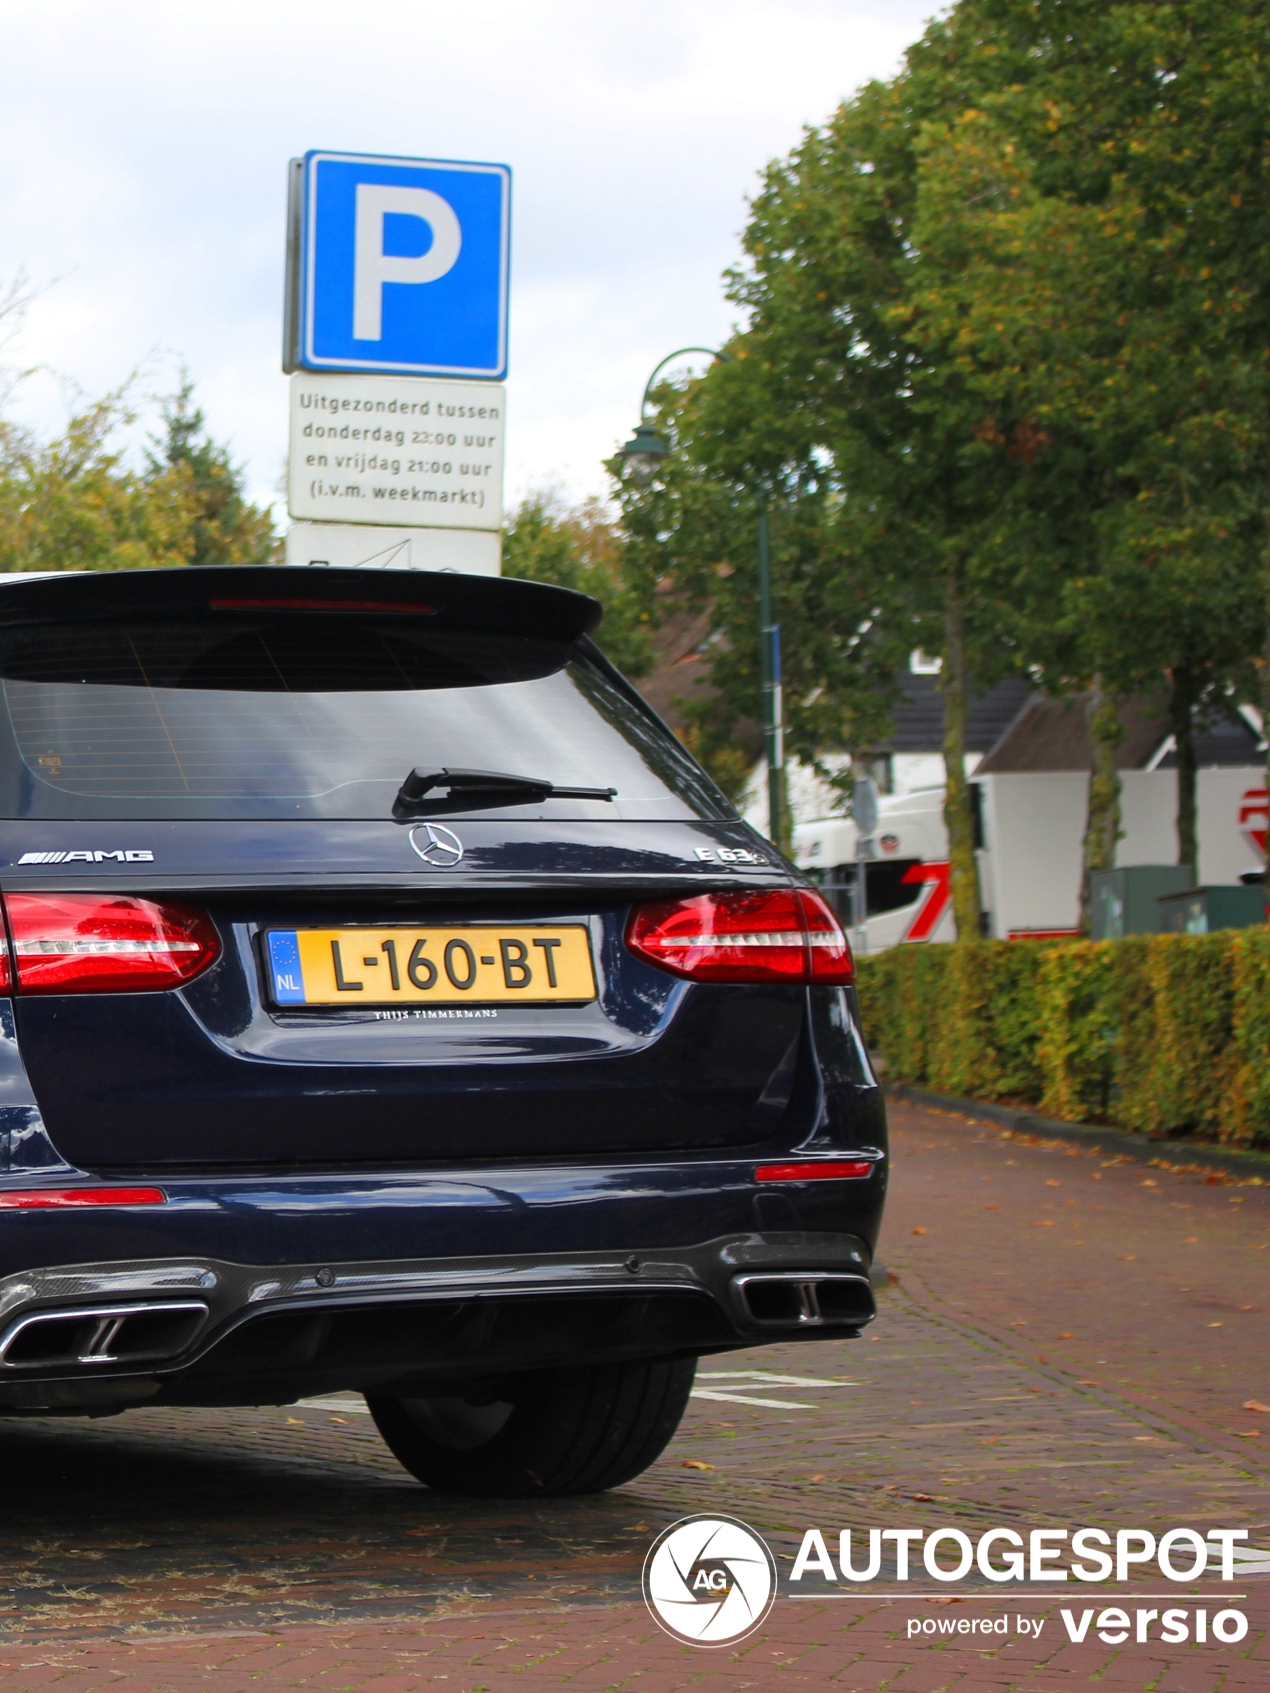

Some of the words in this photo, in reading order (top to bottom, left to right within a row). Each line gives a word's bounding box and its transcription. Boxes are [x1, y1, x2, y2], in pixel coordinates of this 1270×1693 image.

[352, 183, 462, 342] P
[299, 393, 430, 416] Uitgezonderd
[436, 402, 500, 420] tussen
[302, 422, 405, 447] donderdag
[411, 431, 457, 446] 23:00
[463, 434, 497, 448] uur
[305, 454, 328, 467] en
[334, 453, 401, 475] vrijdag
[407, 459, 452, 474] 21:00
[459, 463, 492, 477] uur
[309, 480, 366, 499] (i.v.m.
[372, 486, 485, 509] weekmarkt)
[63, 849, 155, 863] AMG
[330, 938, 561, 991] L-160-BT
[277, 974, 300, 991] NL
[413, 1009, 498, 1019] TIMMERMANS
